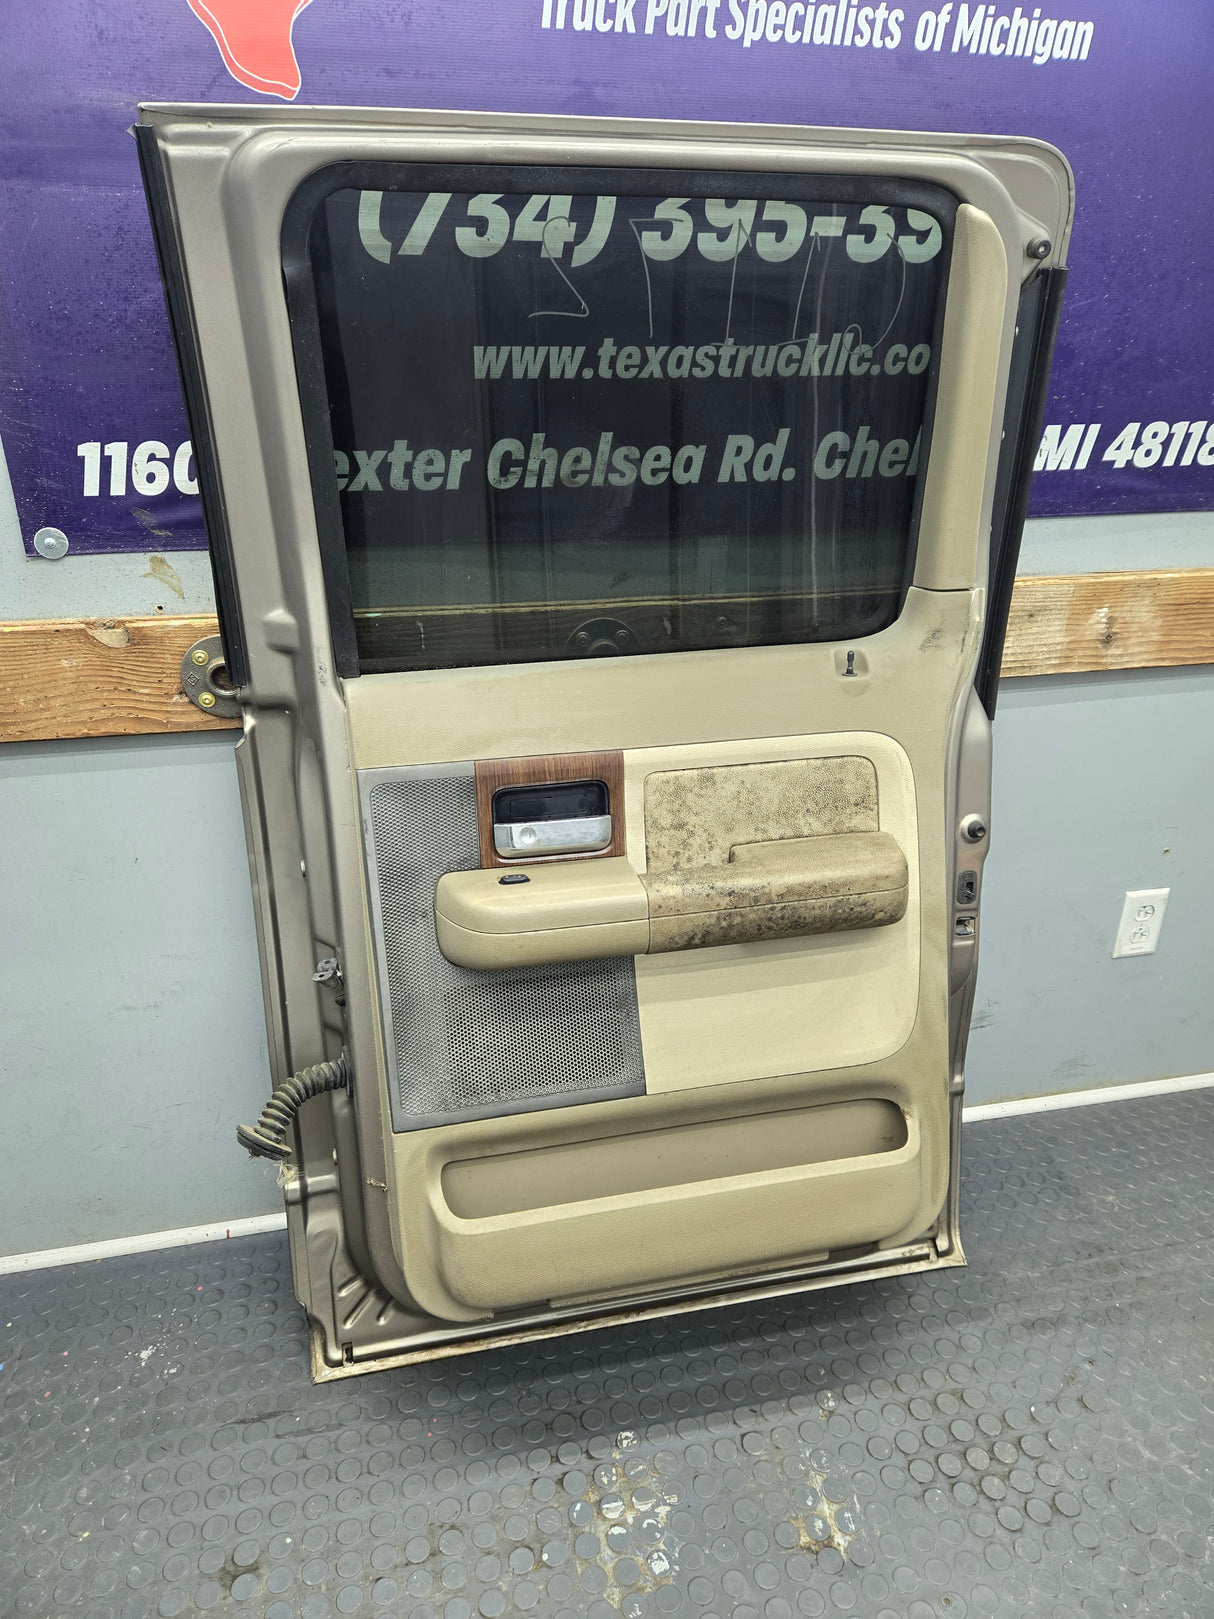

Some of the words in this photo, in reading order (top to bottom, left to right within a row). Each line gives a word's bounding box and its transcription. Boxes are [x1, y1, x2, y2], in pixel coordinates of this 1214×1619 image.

[644, 0, 721, 38] Part
[724, 0, 905, 49] Specialists
[914, 2, 954, 52] of
[951, 3, 1095, 65] Michigan
[473, 332, 932, 380] www.texastruckllc.co
[486, 431, 707, 489] Chelsea
[717, 428, 796, 483] Rd.
[1032, 423, 1101, 471] MI
